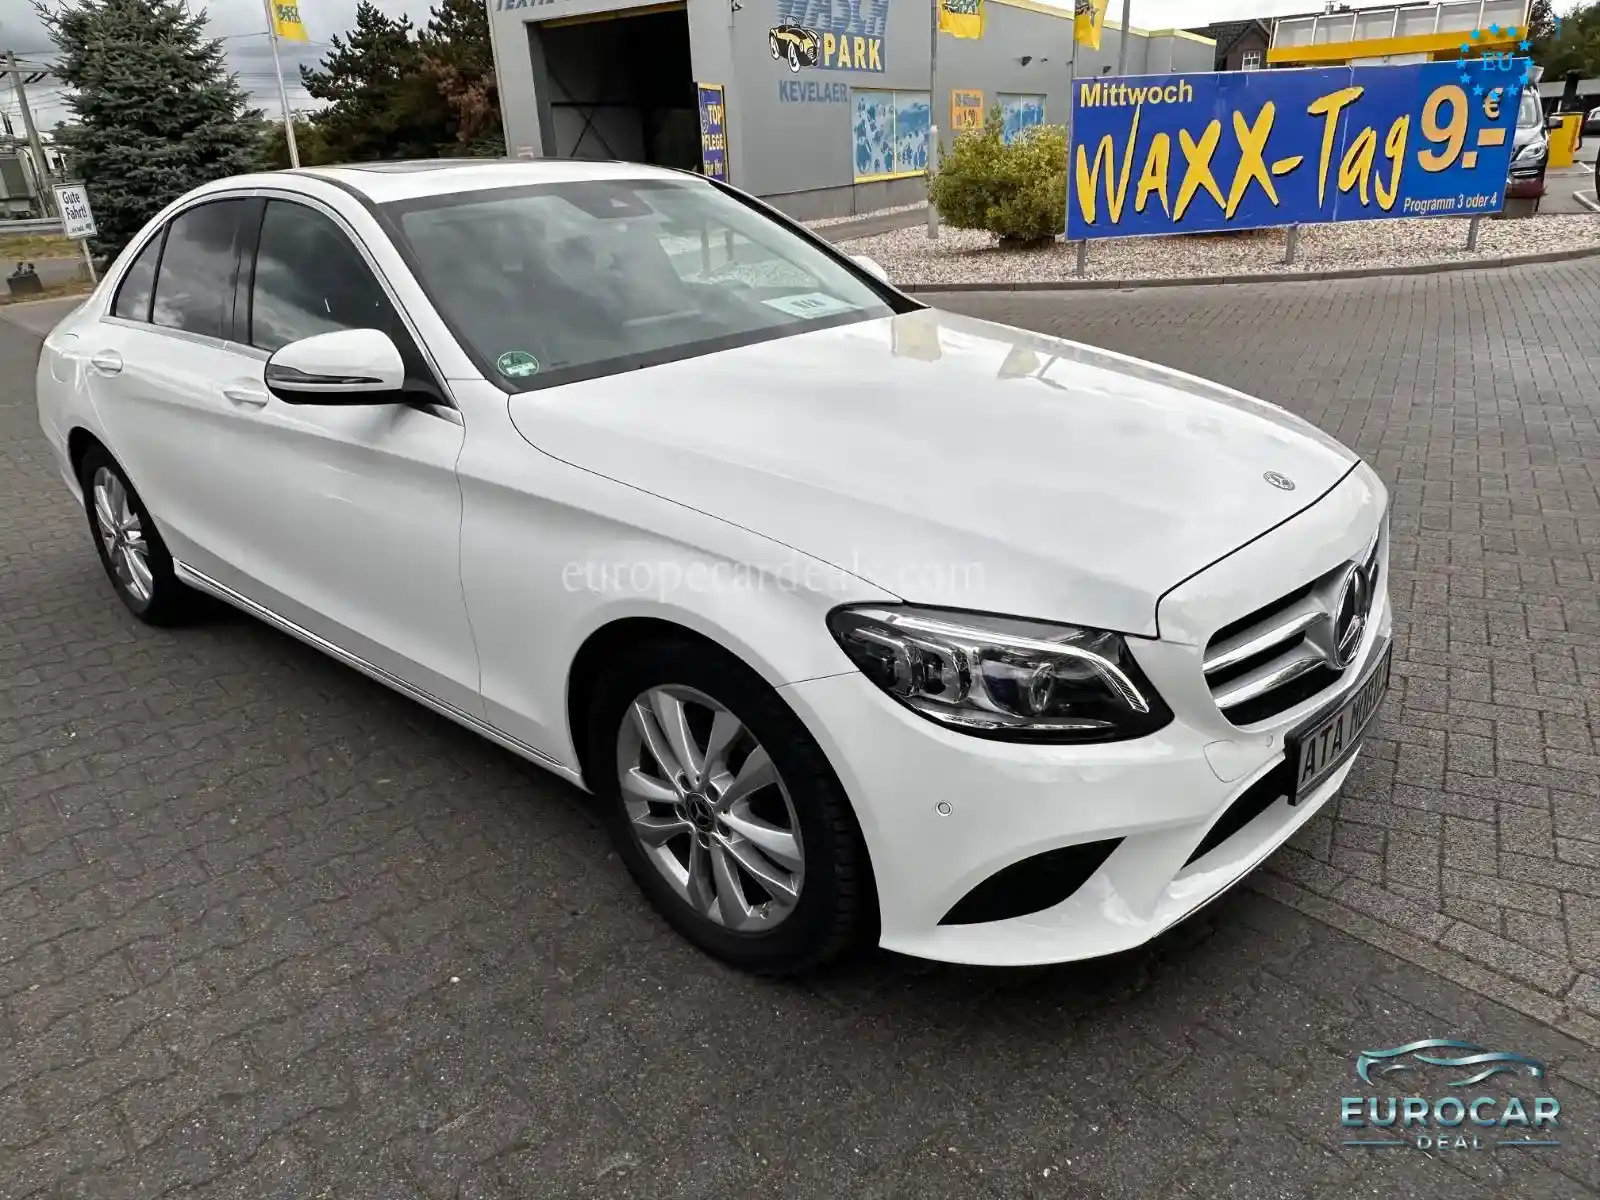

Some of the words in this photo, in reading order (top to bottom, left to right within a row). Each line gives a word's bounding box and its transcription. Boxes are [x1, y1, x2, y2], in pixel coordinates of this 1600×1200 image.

[823, 33, 882, 71] PARK
[779, 80, 848, 103] KEVELAER
[1080, 79, 1193, 108] Mittwoch
[708, 104, 723, 125] TOP
[62, 191, 81, 205] Gute
[1404, 197, 1455, 215] Programm
[1457, 195, 1464, 209] 3
[1466, 193, 1488, 208] oder
[1490, 192, 1498, 206] 4
[65, 204, 88, 220] Fahrt!
[1302, 715, 1343, 782] ATA
